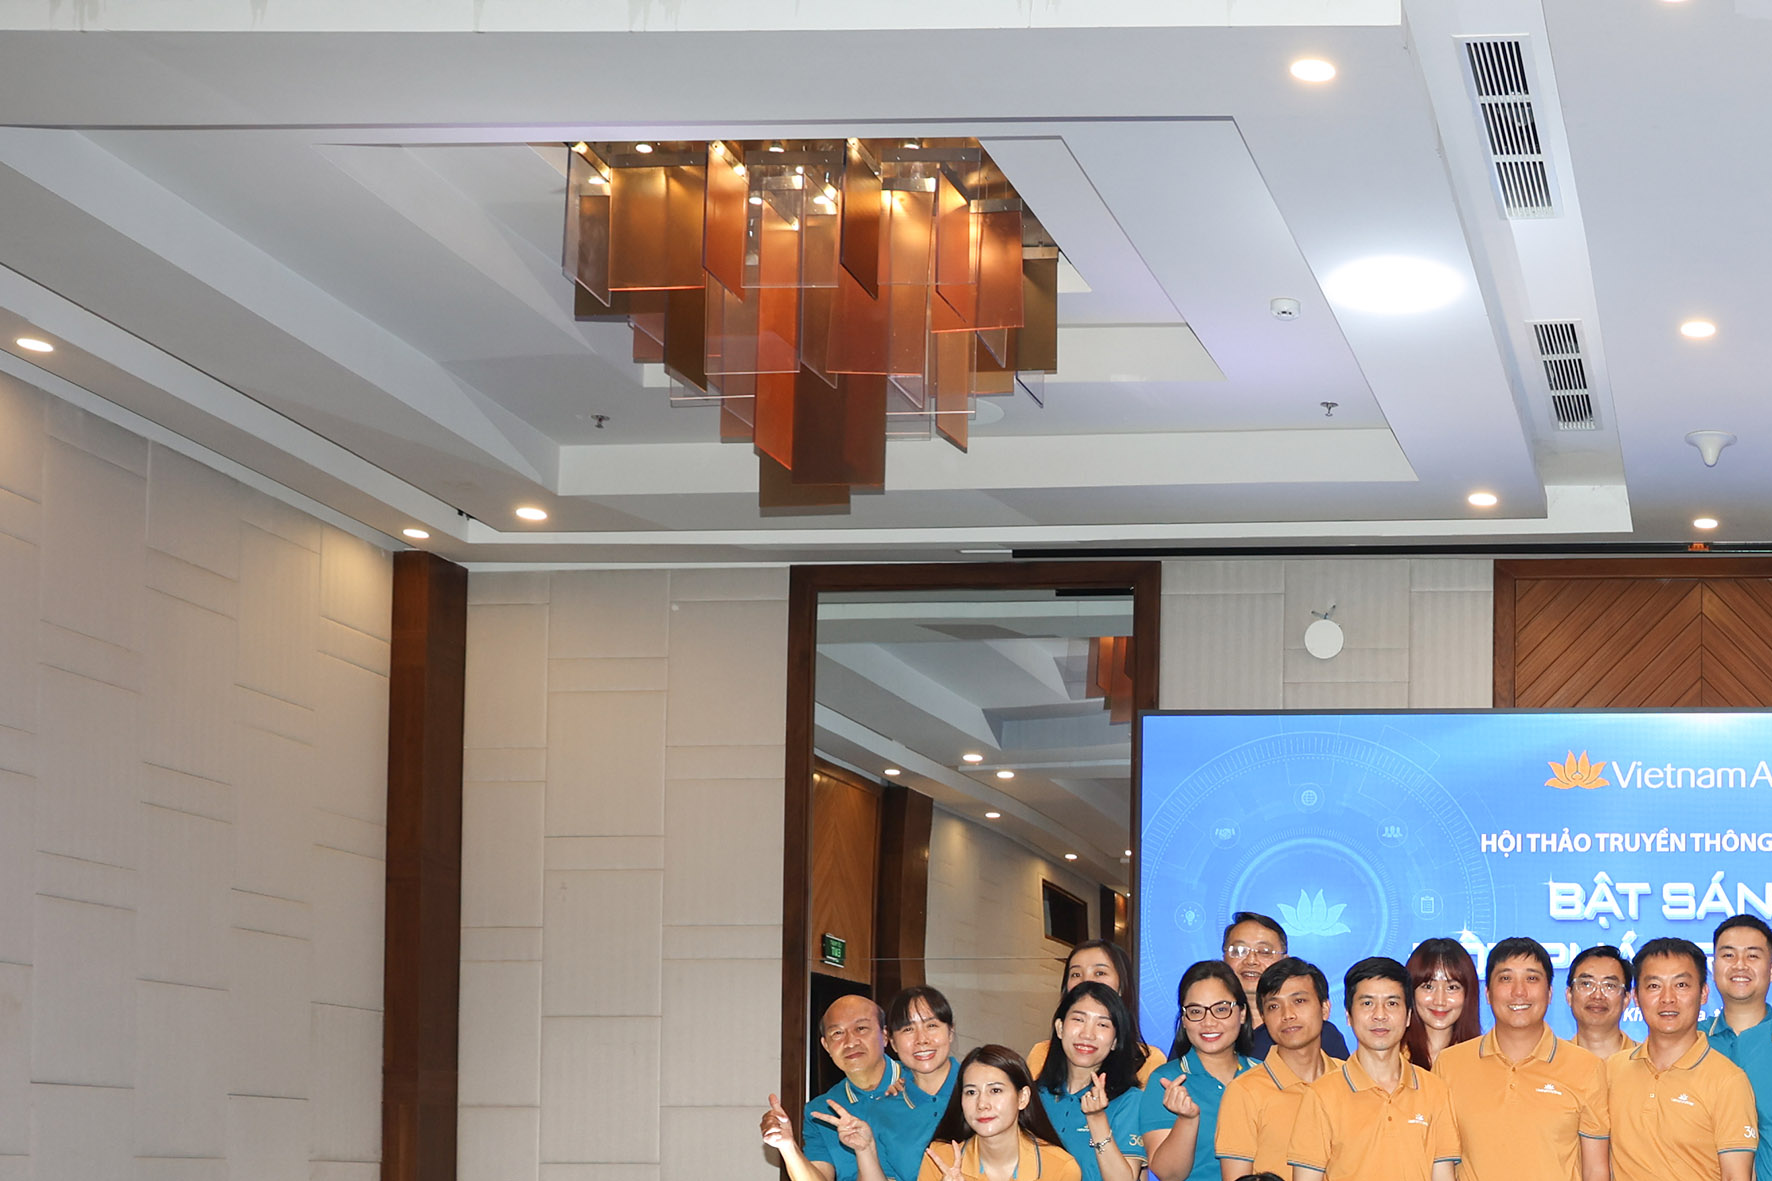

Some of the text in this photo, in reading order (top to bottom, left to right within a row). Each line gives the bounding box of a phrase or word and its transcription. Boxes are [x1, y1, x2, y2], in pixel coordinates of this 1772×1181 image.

[1611, 760, 1746, 789] Vietnam
[1481, 829, 1522, 858] HỘI
[1526, 827, 1592, 852] THẢO
[1595, 827, 1686, 852] TRUYỀN
[1549, 871, 1652, 929] BẬT
